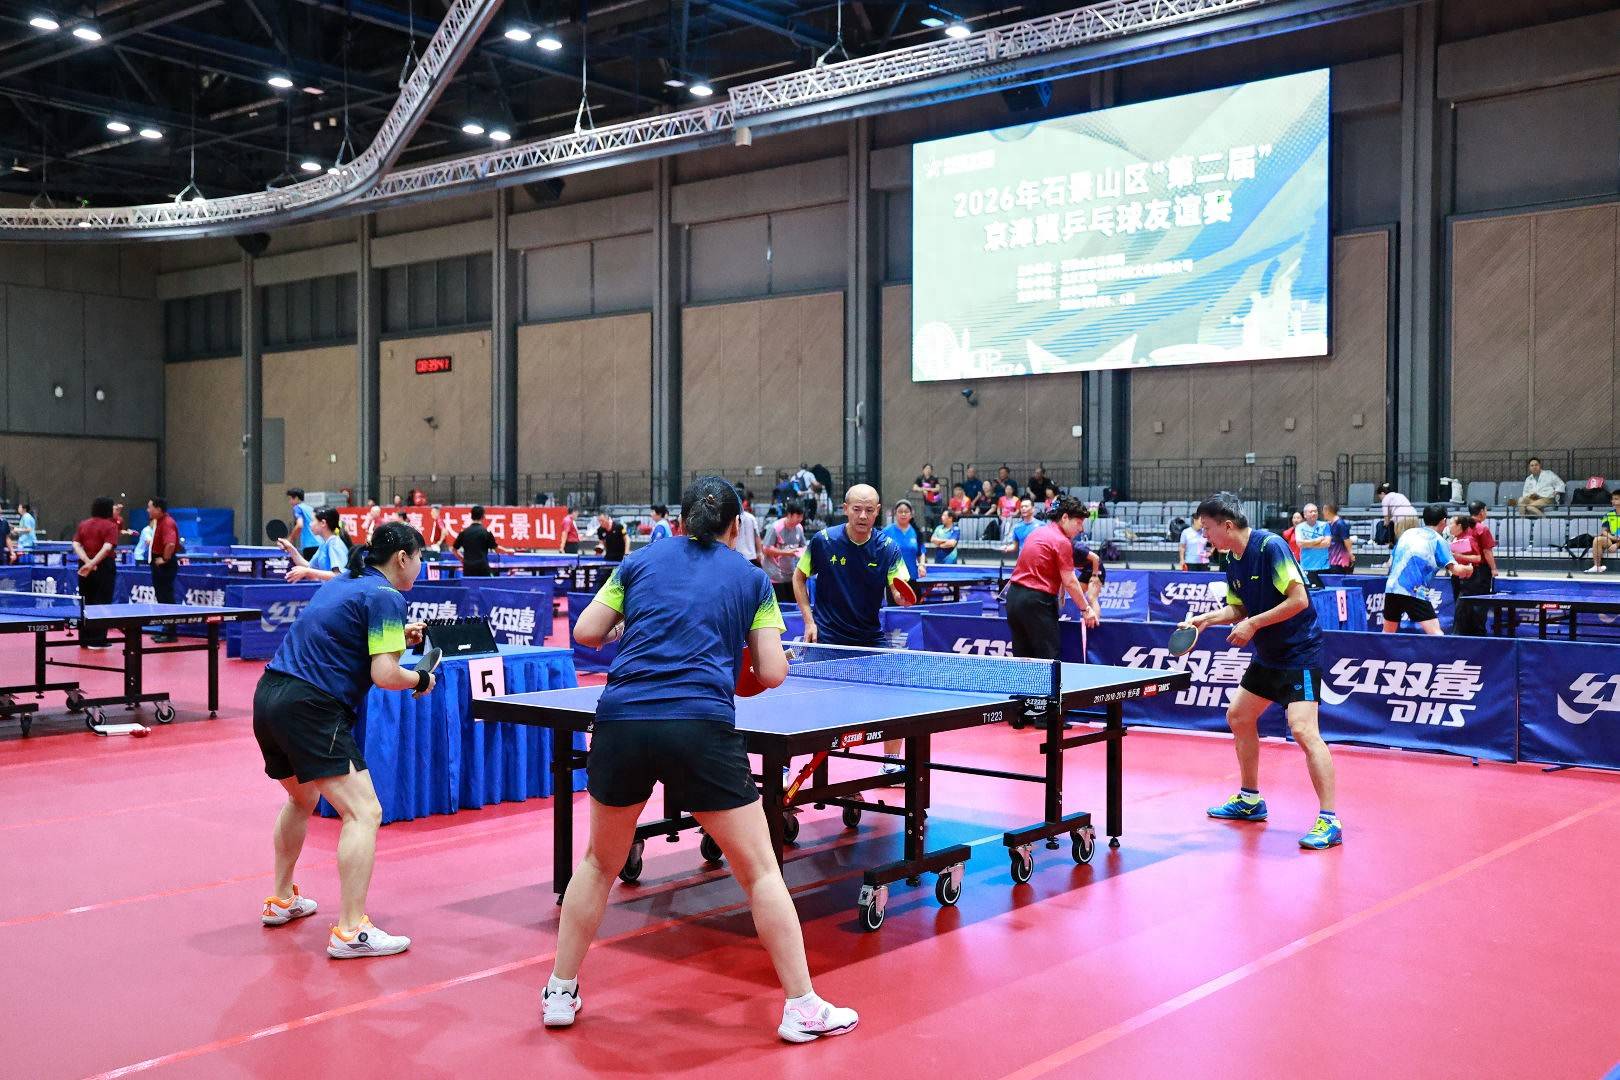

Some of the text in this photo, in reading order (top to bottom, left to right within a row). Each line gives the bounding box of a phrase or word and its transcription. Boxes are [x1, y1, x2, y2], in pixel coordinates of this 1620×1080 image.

[983, 189, 1234, 252] 京津冀乒乓球友谊赛
[489, 606, 536, 637] 红双喜
[1121, 646, 1252, 684] 红双喜
[481, 670, 496, 697] 5
[1320, 657, 1484, 705] 红双喜
[982, 710, 1003, 723] T1223
[1386, 699, 1477, 727] DHS
[866, 730, 884, 741] DHS
